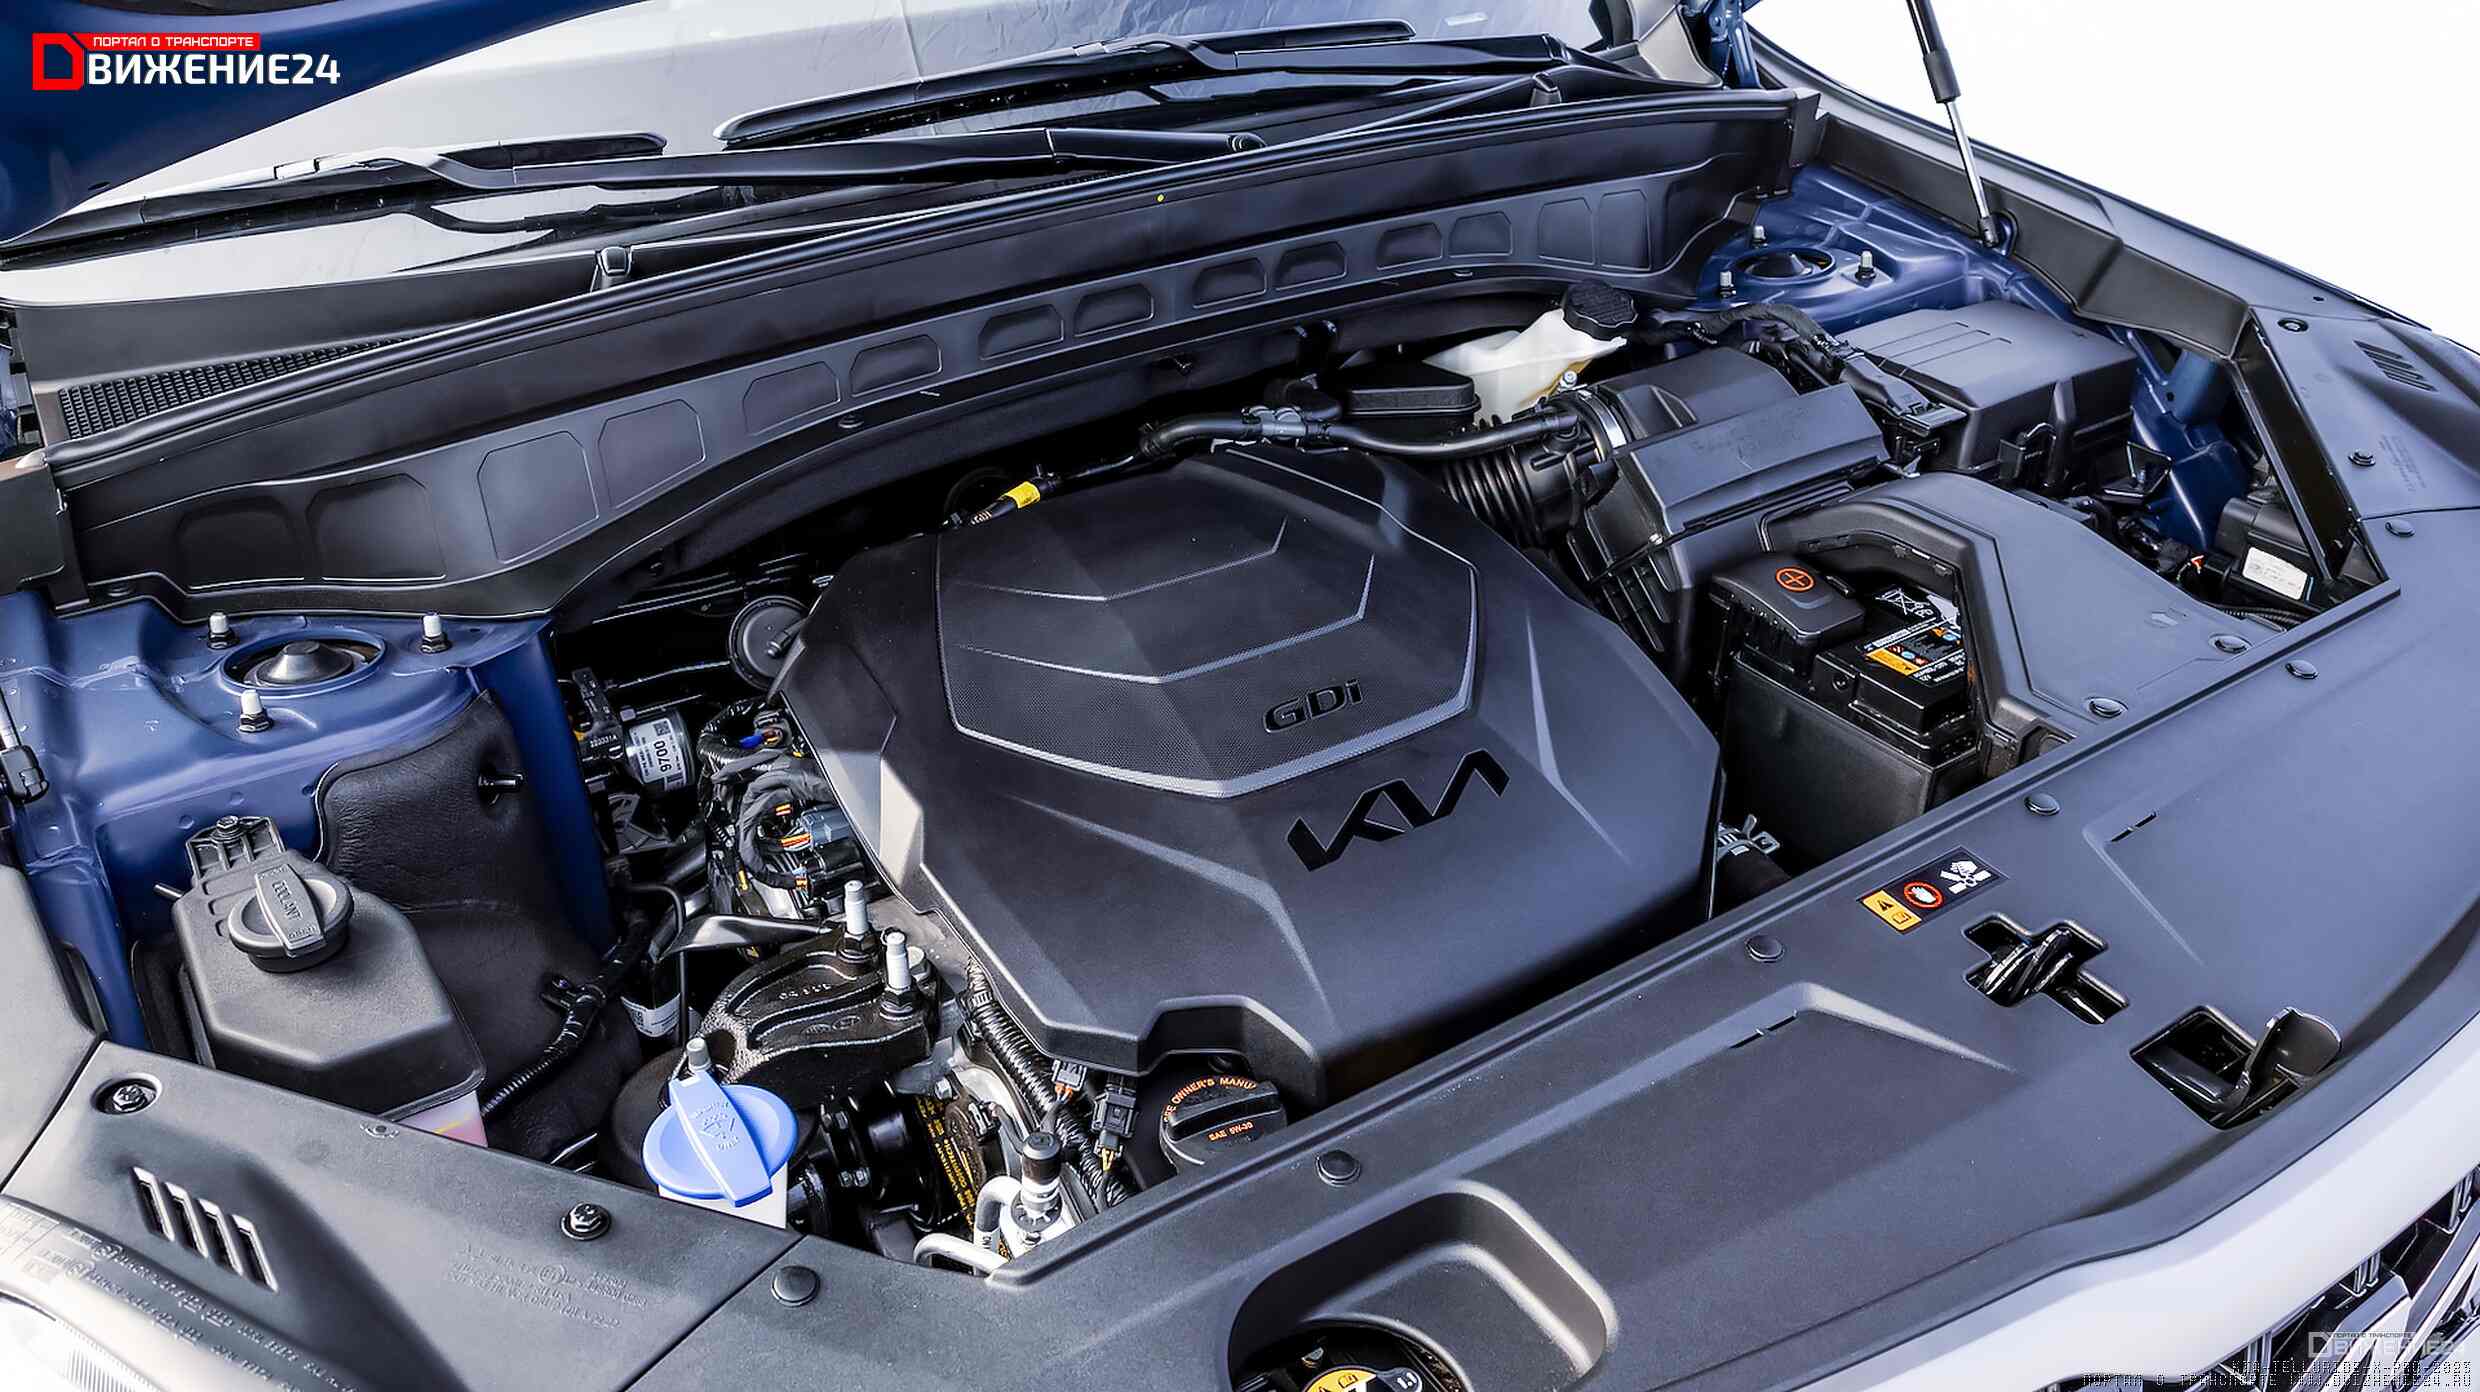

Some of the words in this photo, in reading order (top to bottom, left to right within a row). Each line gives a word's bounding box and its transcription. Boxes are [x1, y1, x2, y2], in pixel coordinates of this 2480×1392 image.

[1262, 679, 1363, 734] GDi
[1285, 748, 1510, 872] KIA
[1171, 1077, 1216, 1104] OWNER'S
